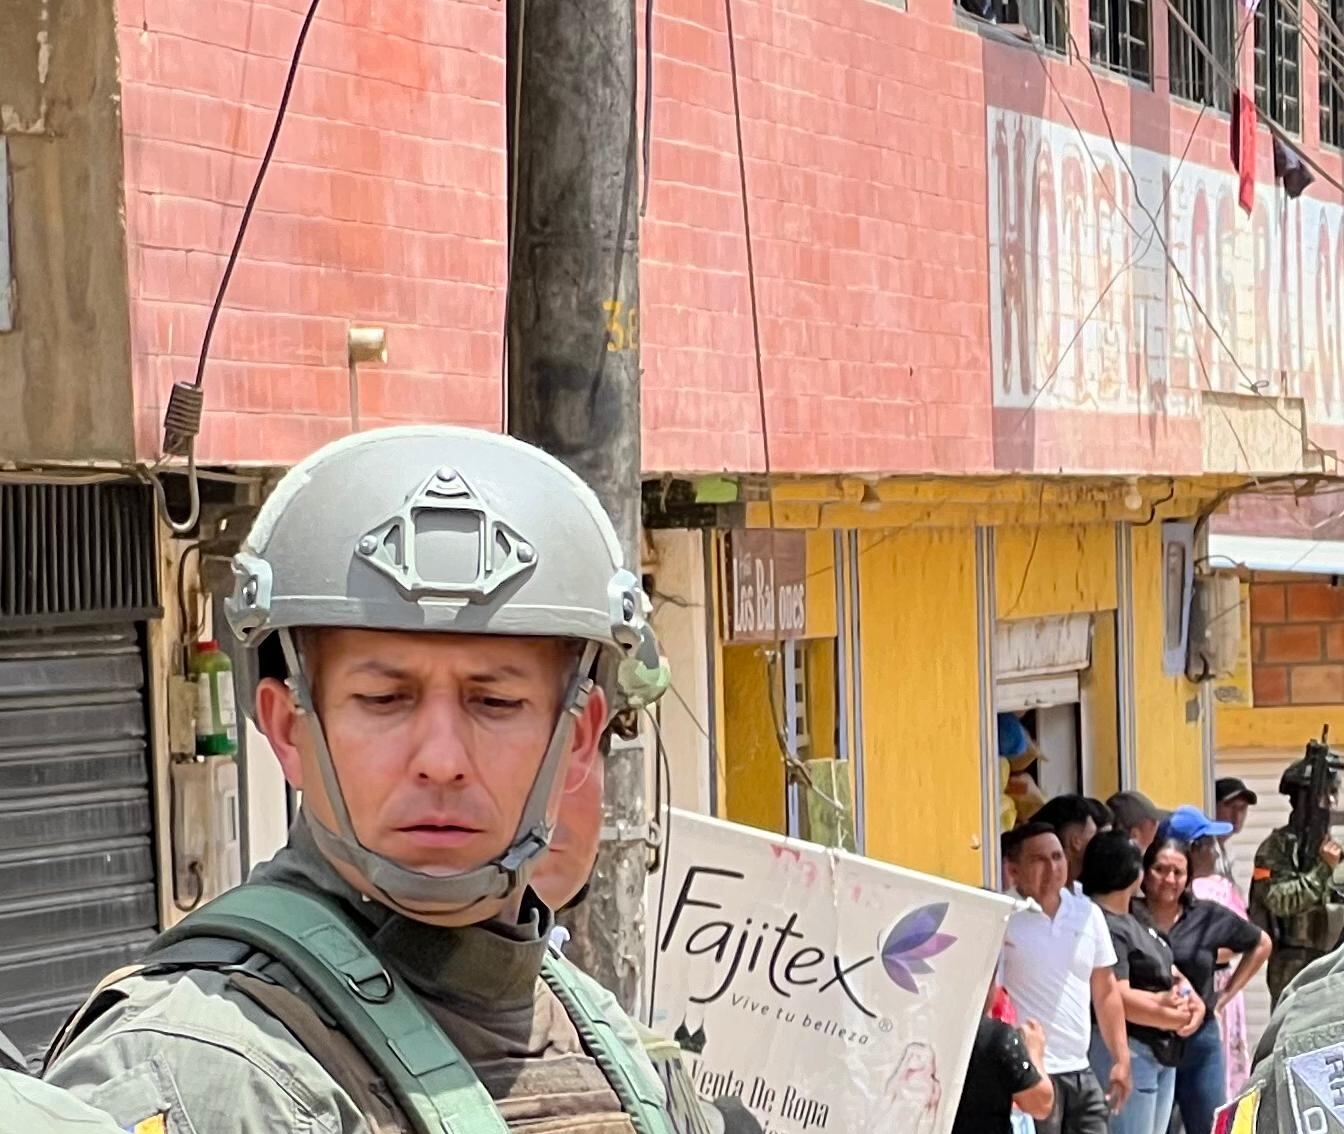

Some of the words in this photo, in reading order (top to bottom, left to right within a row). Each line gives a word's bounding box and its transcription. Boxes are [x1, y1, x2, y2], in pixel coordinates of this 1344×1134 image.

[755, 557, 804, 631] Balones
[661, 866, 877, 1019] Fajitex
[732, 993, 770, 1016] Vive
[776, 1009, 796, 1023] tu
[802, 1014, 869, 1046] belleza
[691, 1059, 744, 1098] Venta
[749, 1076, 776, 1113] De
[780, 1085, 829, 1130] Ropa
